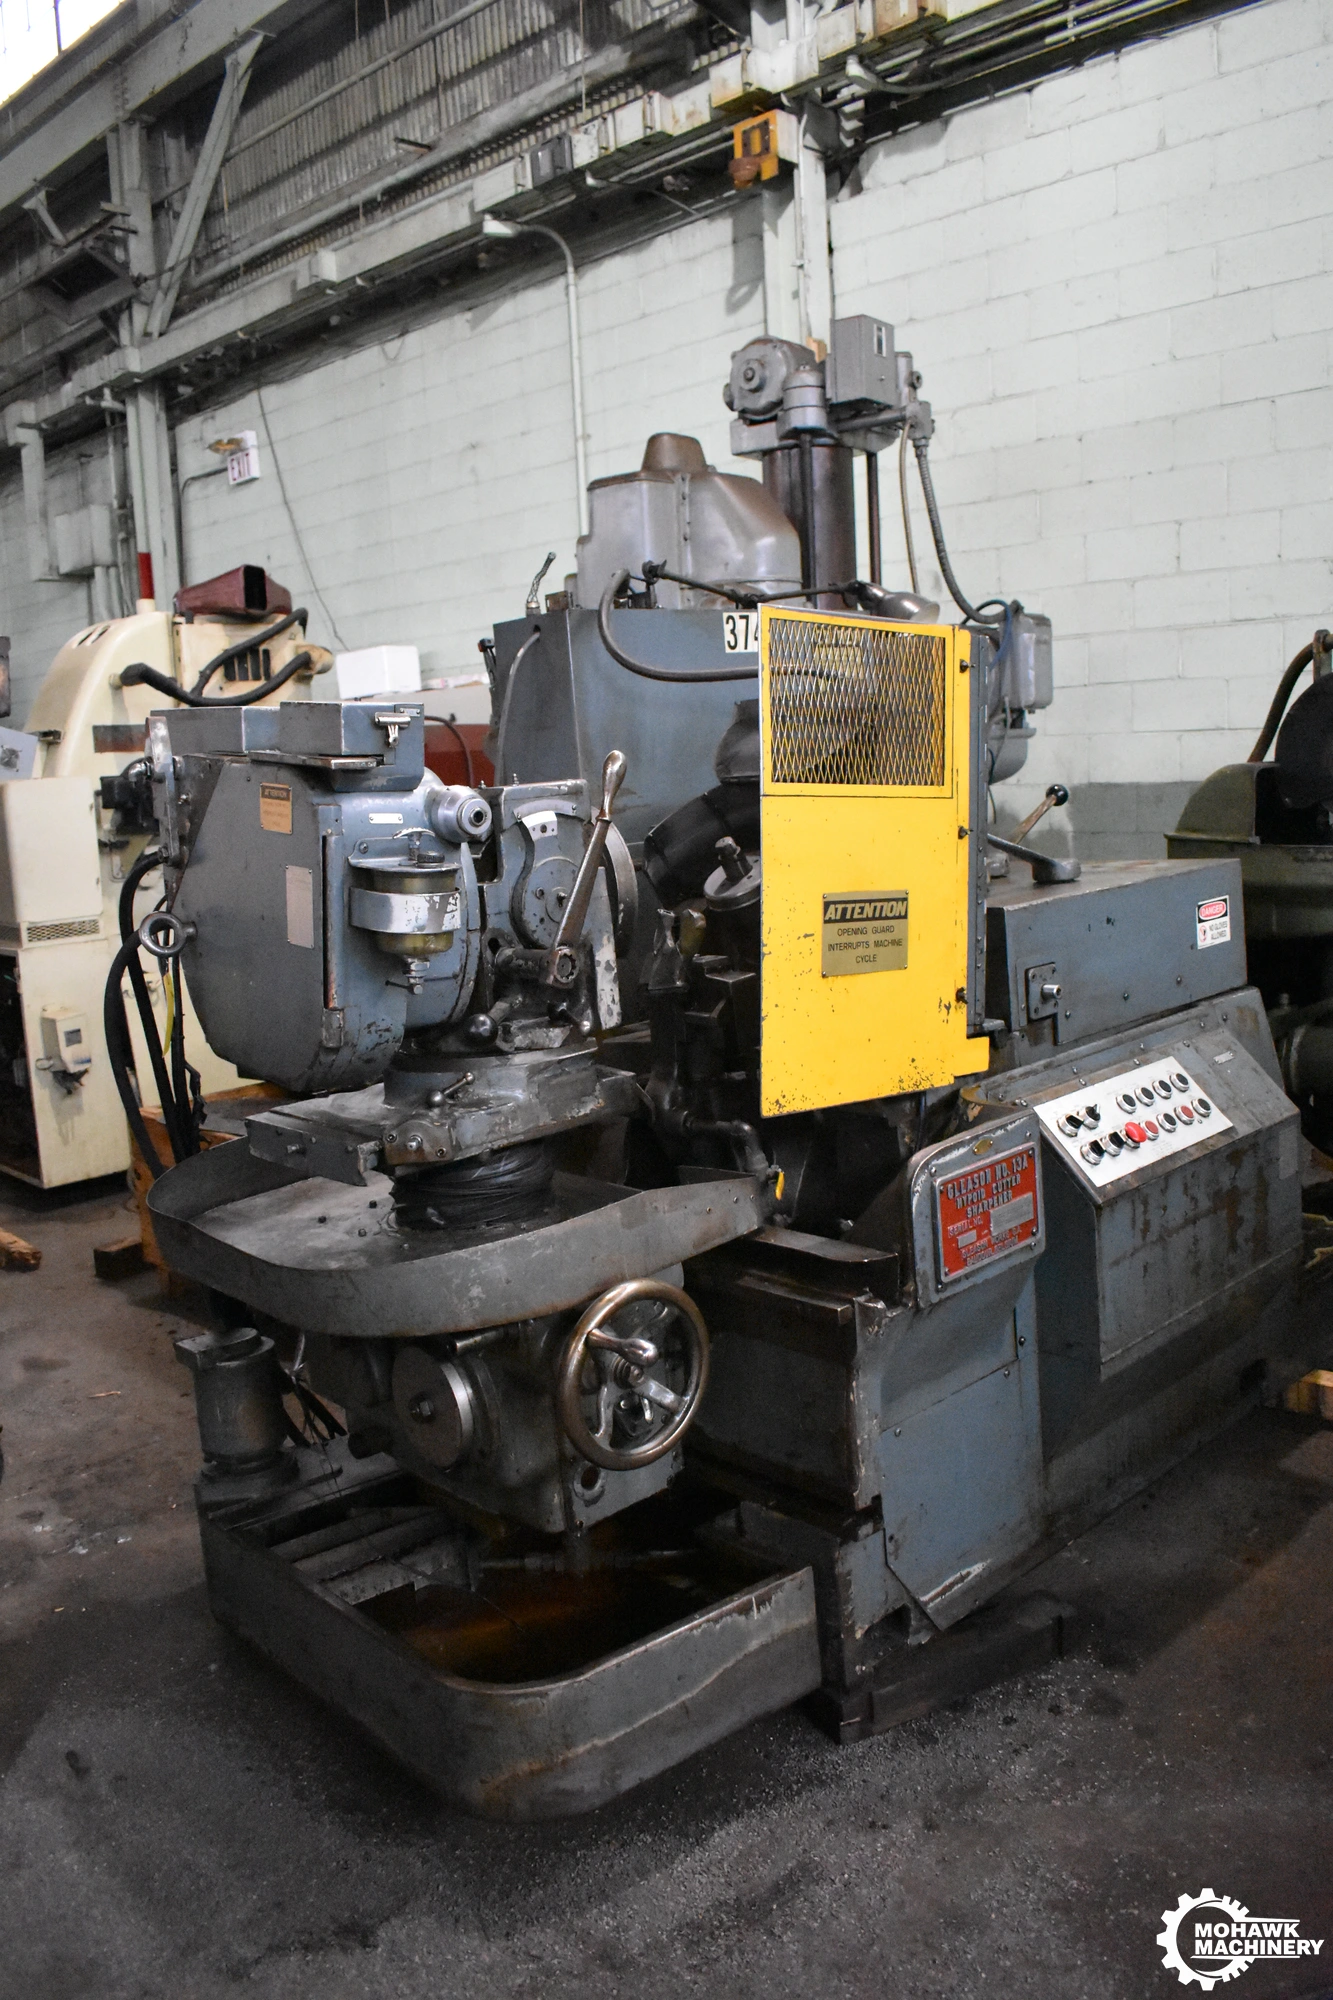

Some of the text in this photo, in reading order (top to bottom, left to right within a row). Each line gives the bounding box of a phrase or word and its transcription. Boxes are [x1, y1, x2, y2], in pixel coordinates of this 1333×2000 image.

[230, 452, 250, 481] EXIT
[824, 900, 907, 920] ATTENTION
[1202, 903, 1224, 916] DANGER
[837, 925, 895, 937] OPENING GUARD
[828, 938, 903, 952] INTERRUPTS MACHINE
[855, 954, 877, 964] CYCLE
[947, 1154, 1028, 1200] GLEASON NO. 13A
[956, 1173, 1020, 1209] HYPOID CUTTER
[967, 1190, 1012, 1218] SHARPENER
[948, 1219, 973, 1237] SERIAL
[962, 1238, 989, 1259] GLEASON
